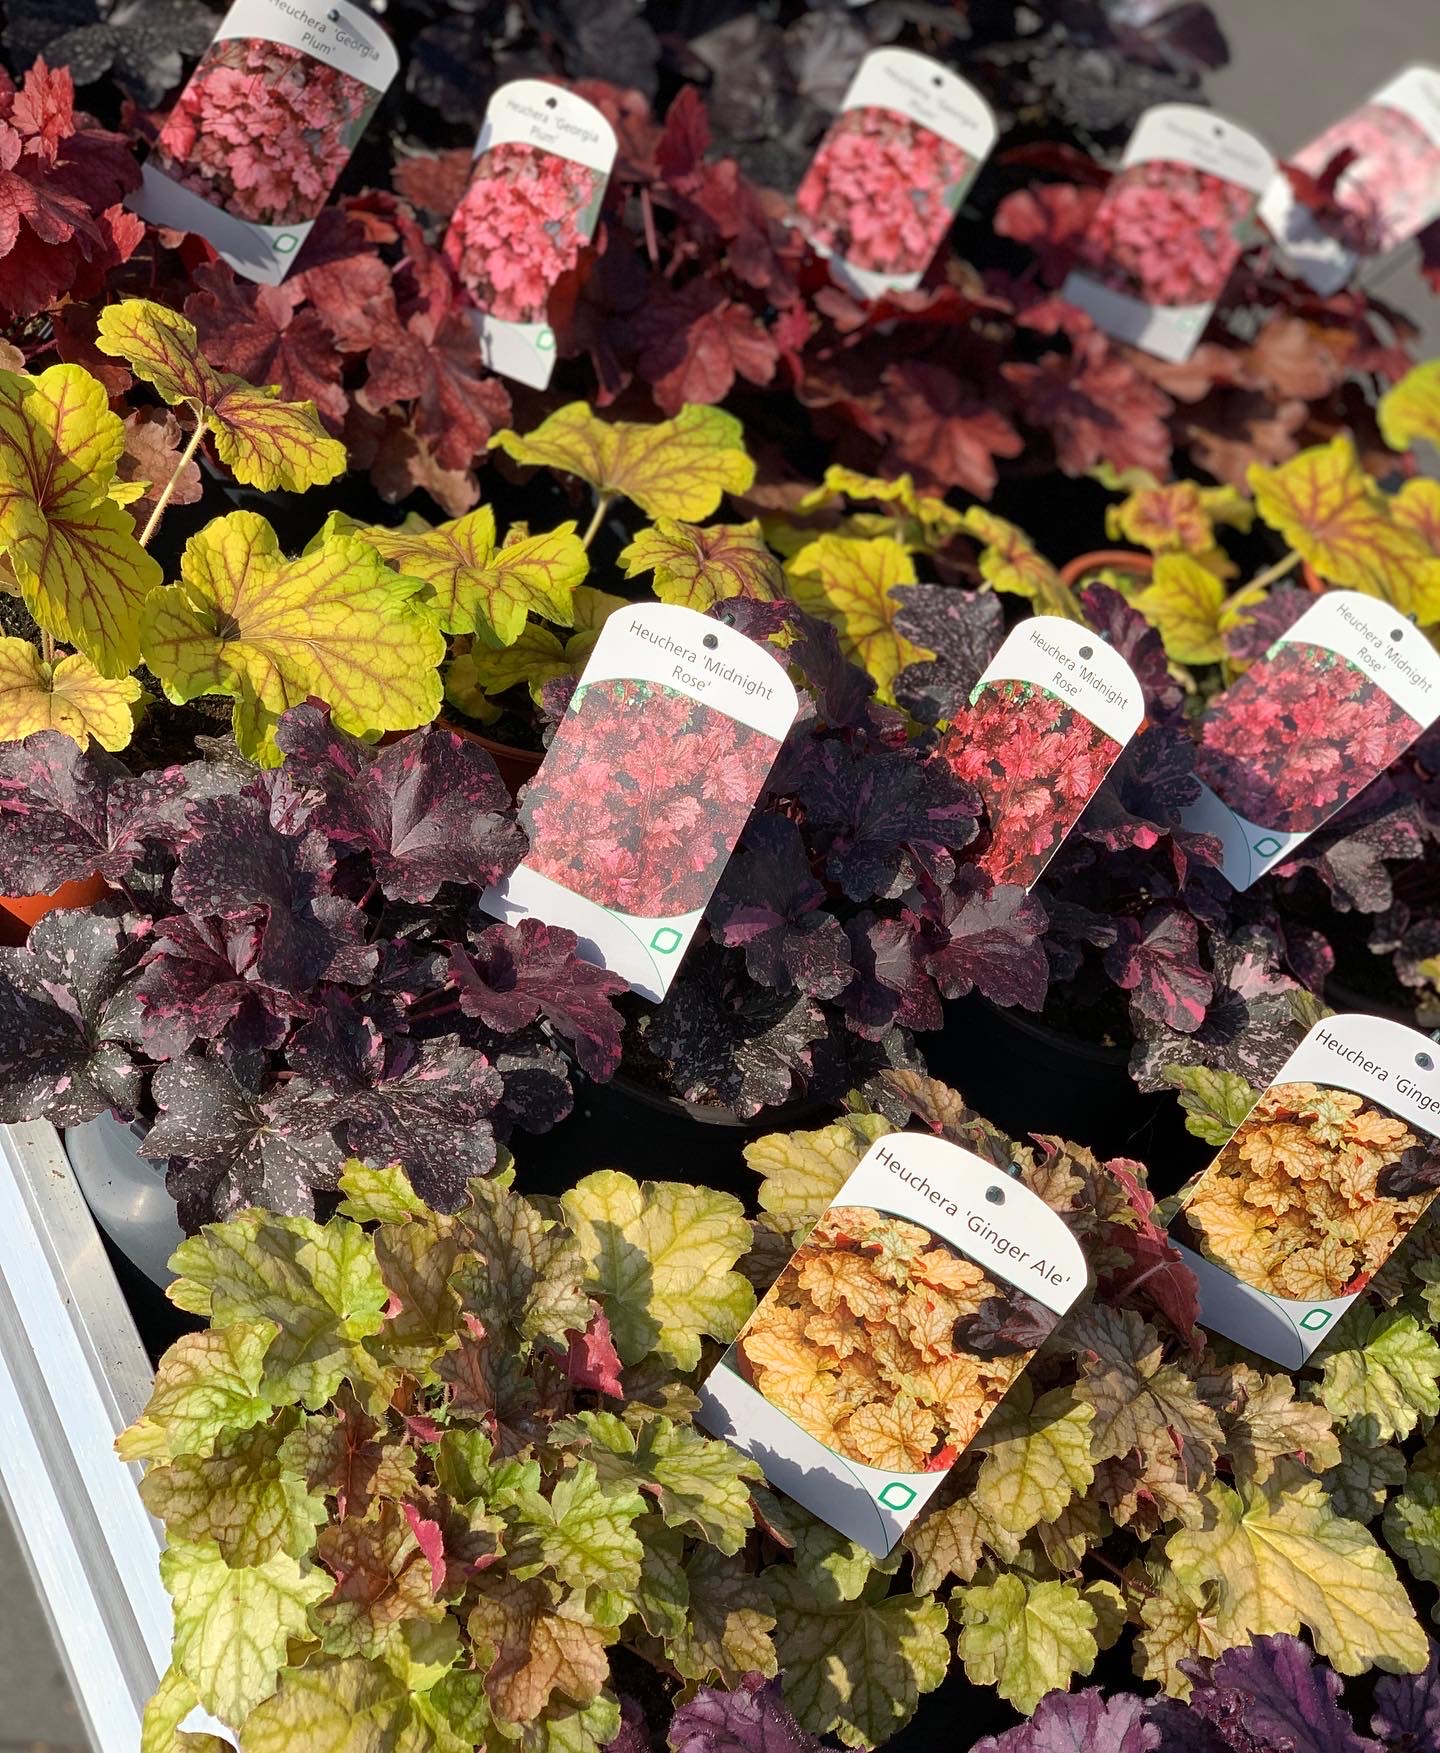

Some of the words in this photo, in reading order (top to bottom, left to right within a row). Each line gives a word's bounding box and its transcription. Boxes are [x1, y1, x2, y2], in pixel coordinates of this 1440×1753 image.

[301, 31, 336, 55] Plum'
[334, 28, 380, 61] 'Georgia
[629, 620, 697, 663] Heuchera
[703, 655, 774, 700] 'Midnight
[1029, 631, 1076, 671] Heuchera
[1079, 665, 1129, 710] 'Midnight
[1337, 604, 1383, 648] Heuchera
[1384, 644, 1433, 693] 'Midnight
[1356, 646, 1386, 672] Rose'
[671, 665, 712, 691] Rose'
[1052, 671, 1083, 697] Rose'
[1315, 1028, 1389, 1082] Heuchera
[1395, 1074, 1440, 1115] 'Ginge
[875, 1147, 959, 1216] Heuchera
[966, 1211, 1030, 1263] 'Ginger
[1030, 1259, 1071, 1287] Ale'
